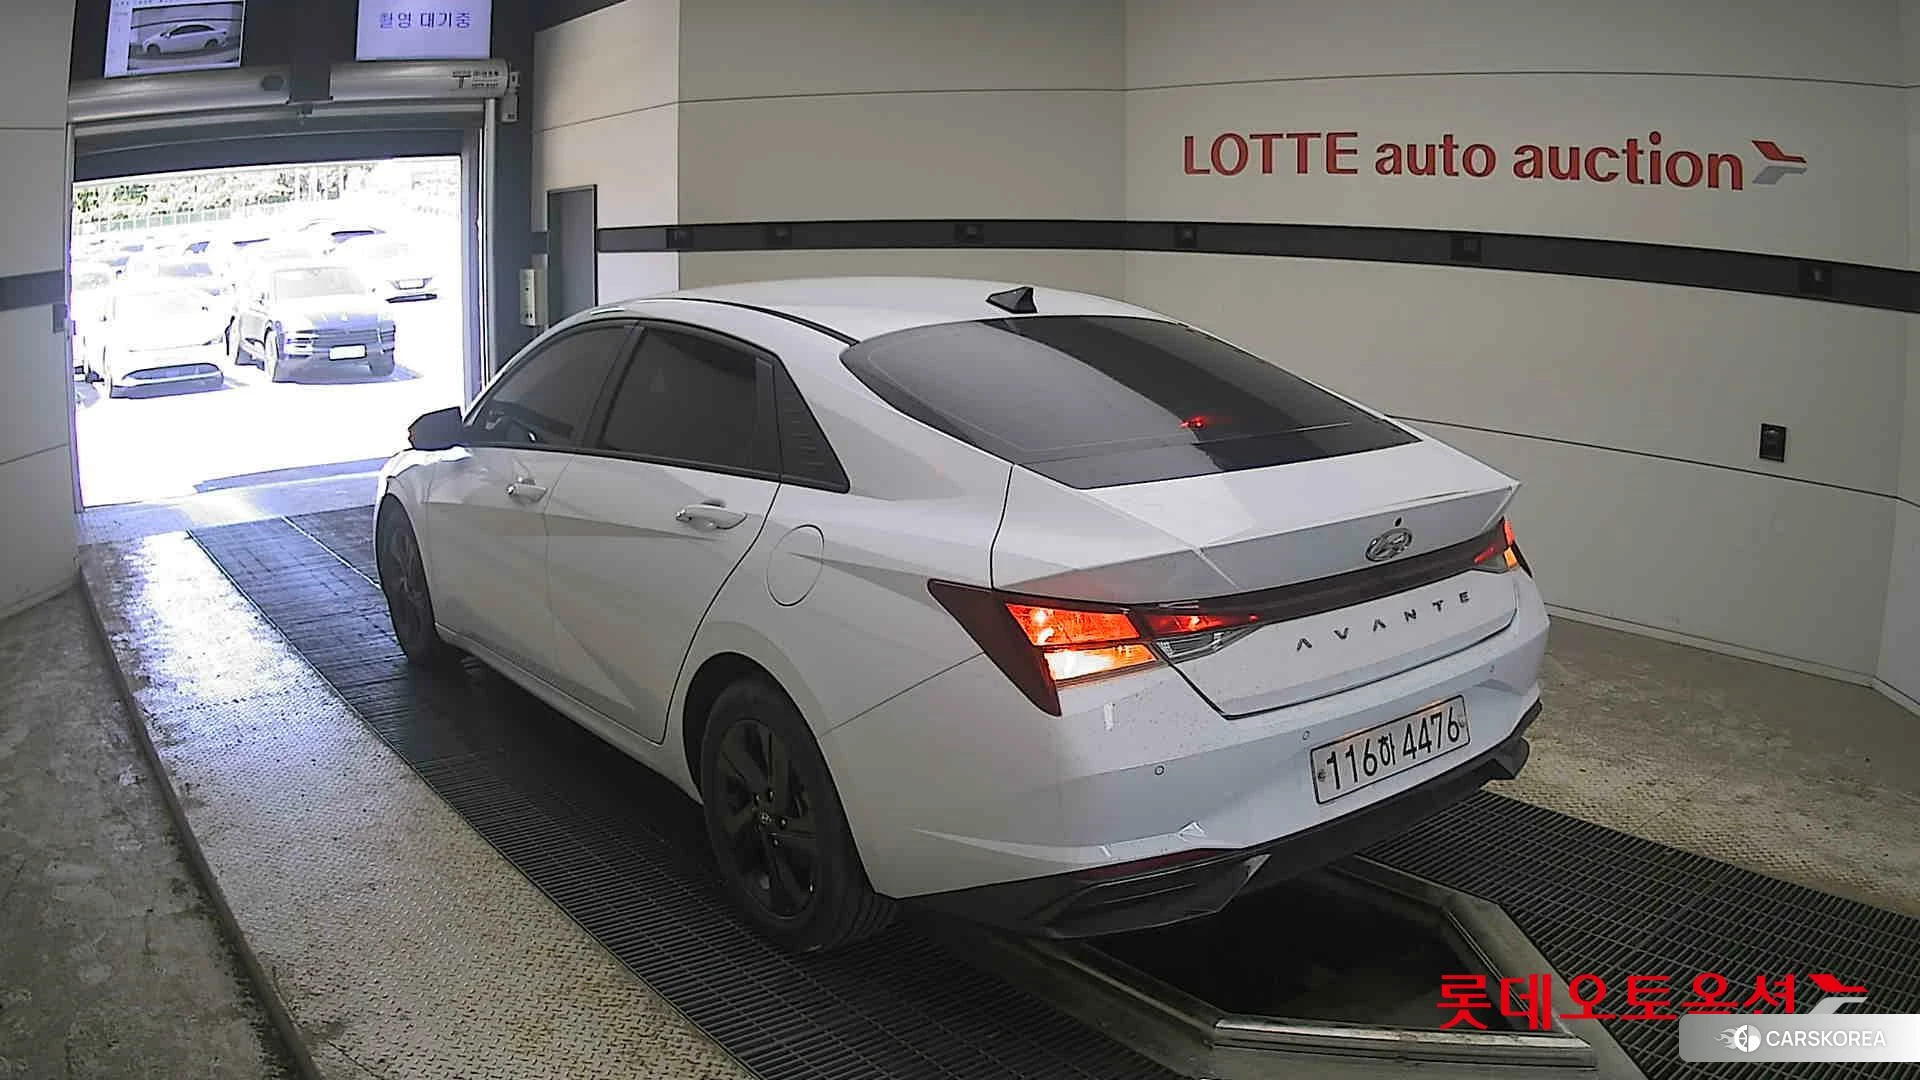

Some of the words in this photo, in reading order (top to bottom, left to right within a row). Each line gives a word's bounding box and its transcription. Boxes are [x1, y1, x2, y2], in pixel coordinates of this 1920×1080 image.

[1184, 132, 1358, 176] LOTTE
[1375, 134, 1496, 177] auto
[1513, 131, 1743, 190] auction
[1297, 591, 1470, 651] AVANTE
[1403, 706, 1460, 760] 4476
